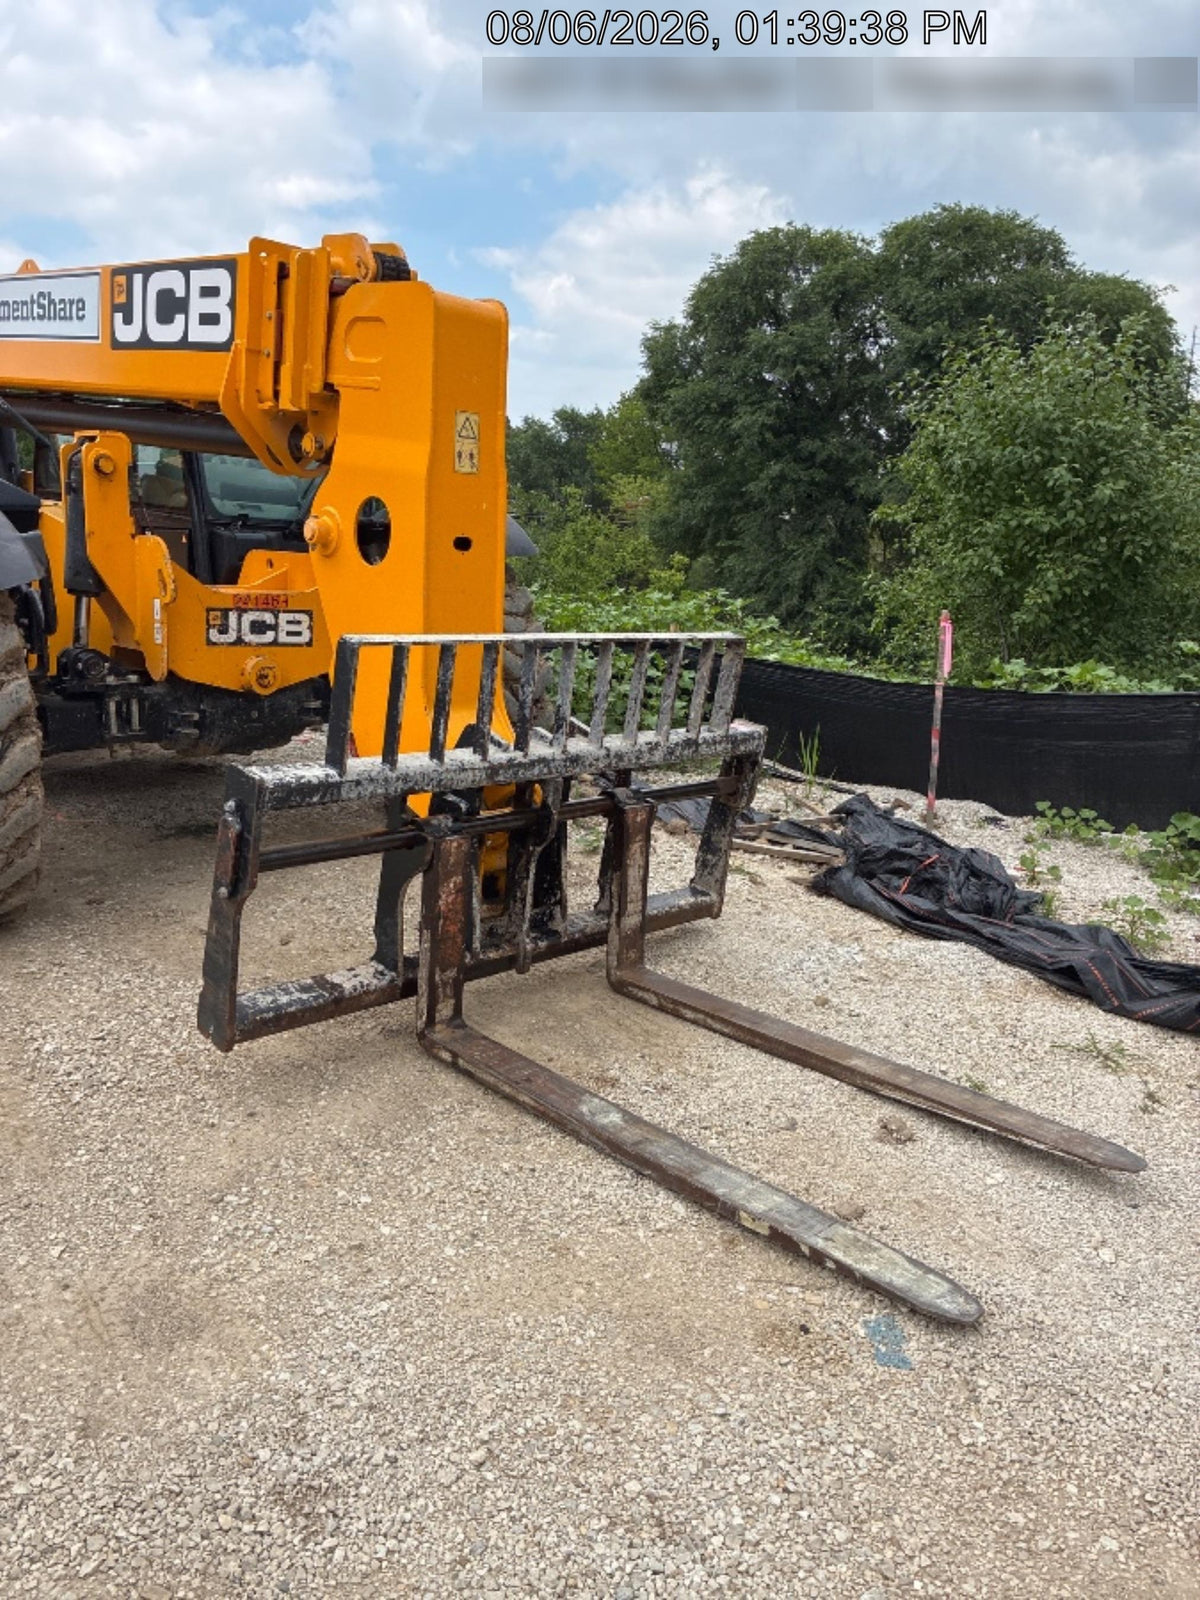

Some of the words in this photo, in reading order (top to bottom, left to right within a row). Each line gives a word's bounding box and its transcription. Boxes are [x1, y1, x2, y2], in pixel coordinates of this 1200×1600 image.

[0, 291, 86, 321] mentShare
[113, 268, 232, 342] JCB
[208, 611, 311, 643] JCB
